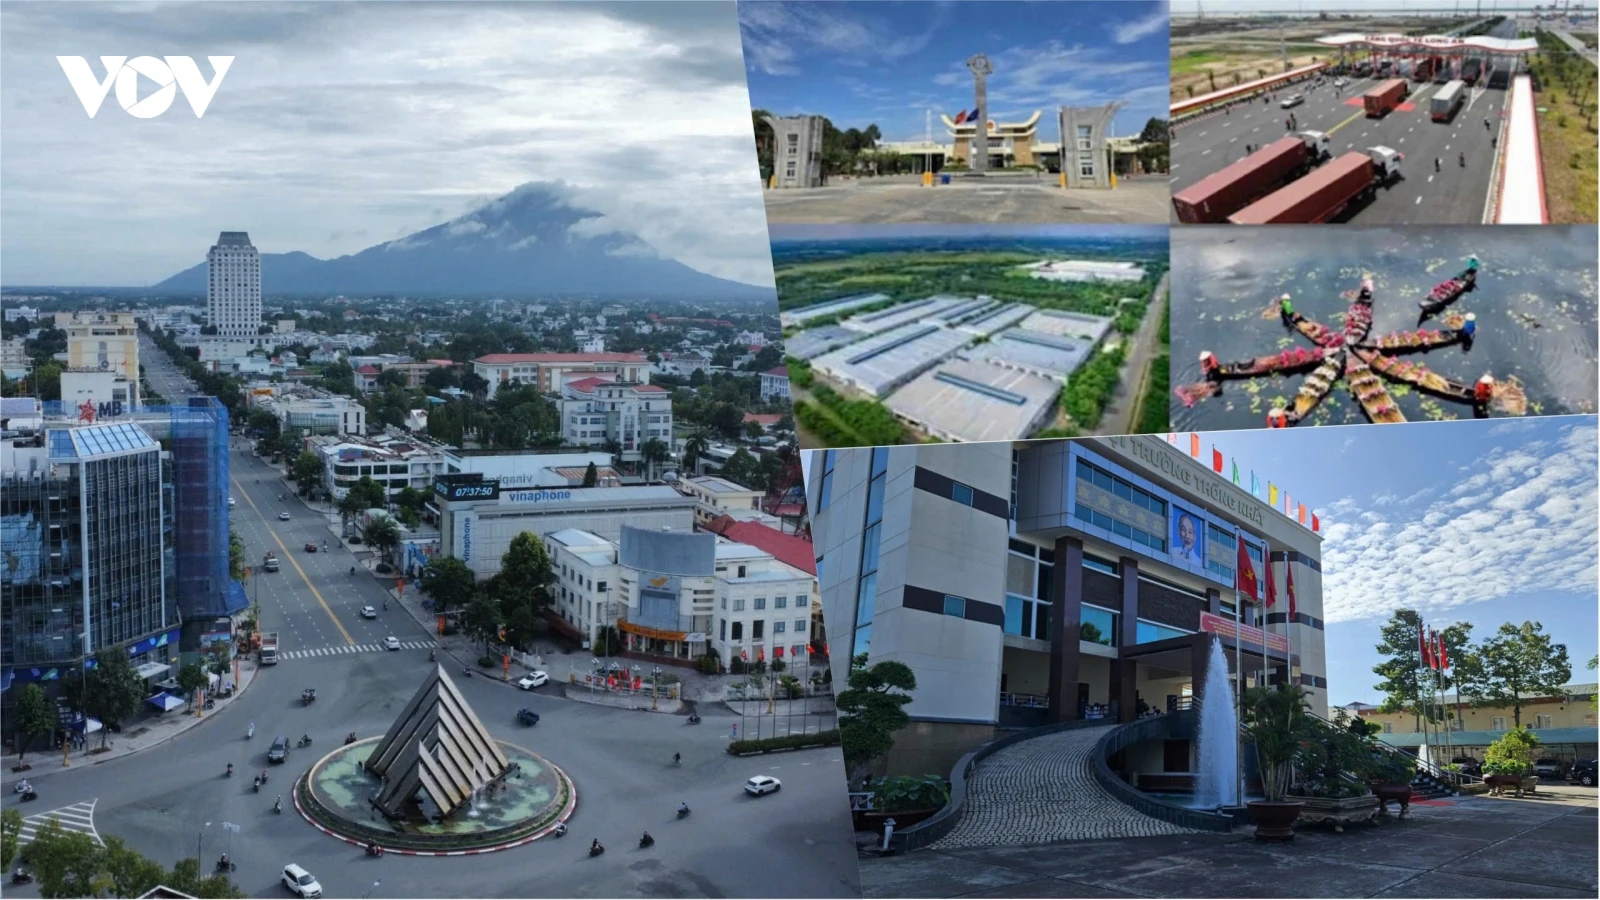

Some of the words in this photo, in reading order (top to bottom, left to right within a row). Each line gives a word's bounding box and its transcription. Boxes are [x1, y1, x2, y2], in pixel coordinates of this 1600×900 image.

[98, 401, 122, 418] MB
[1130, 438, 1190, 485] TRƯỜNG
[1194, 474, 1236, 510] THỐNG
[1238, 503, 1265, 526] NHẤT
[455, 487, 493, 497] 07:37:50
[509, 489, 571, 503] vinaphone
